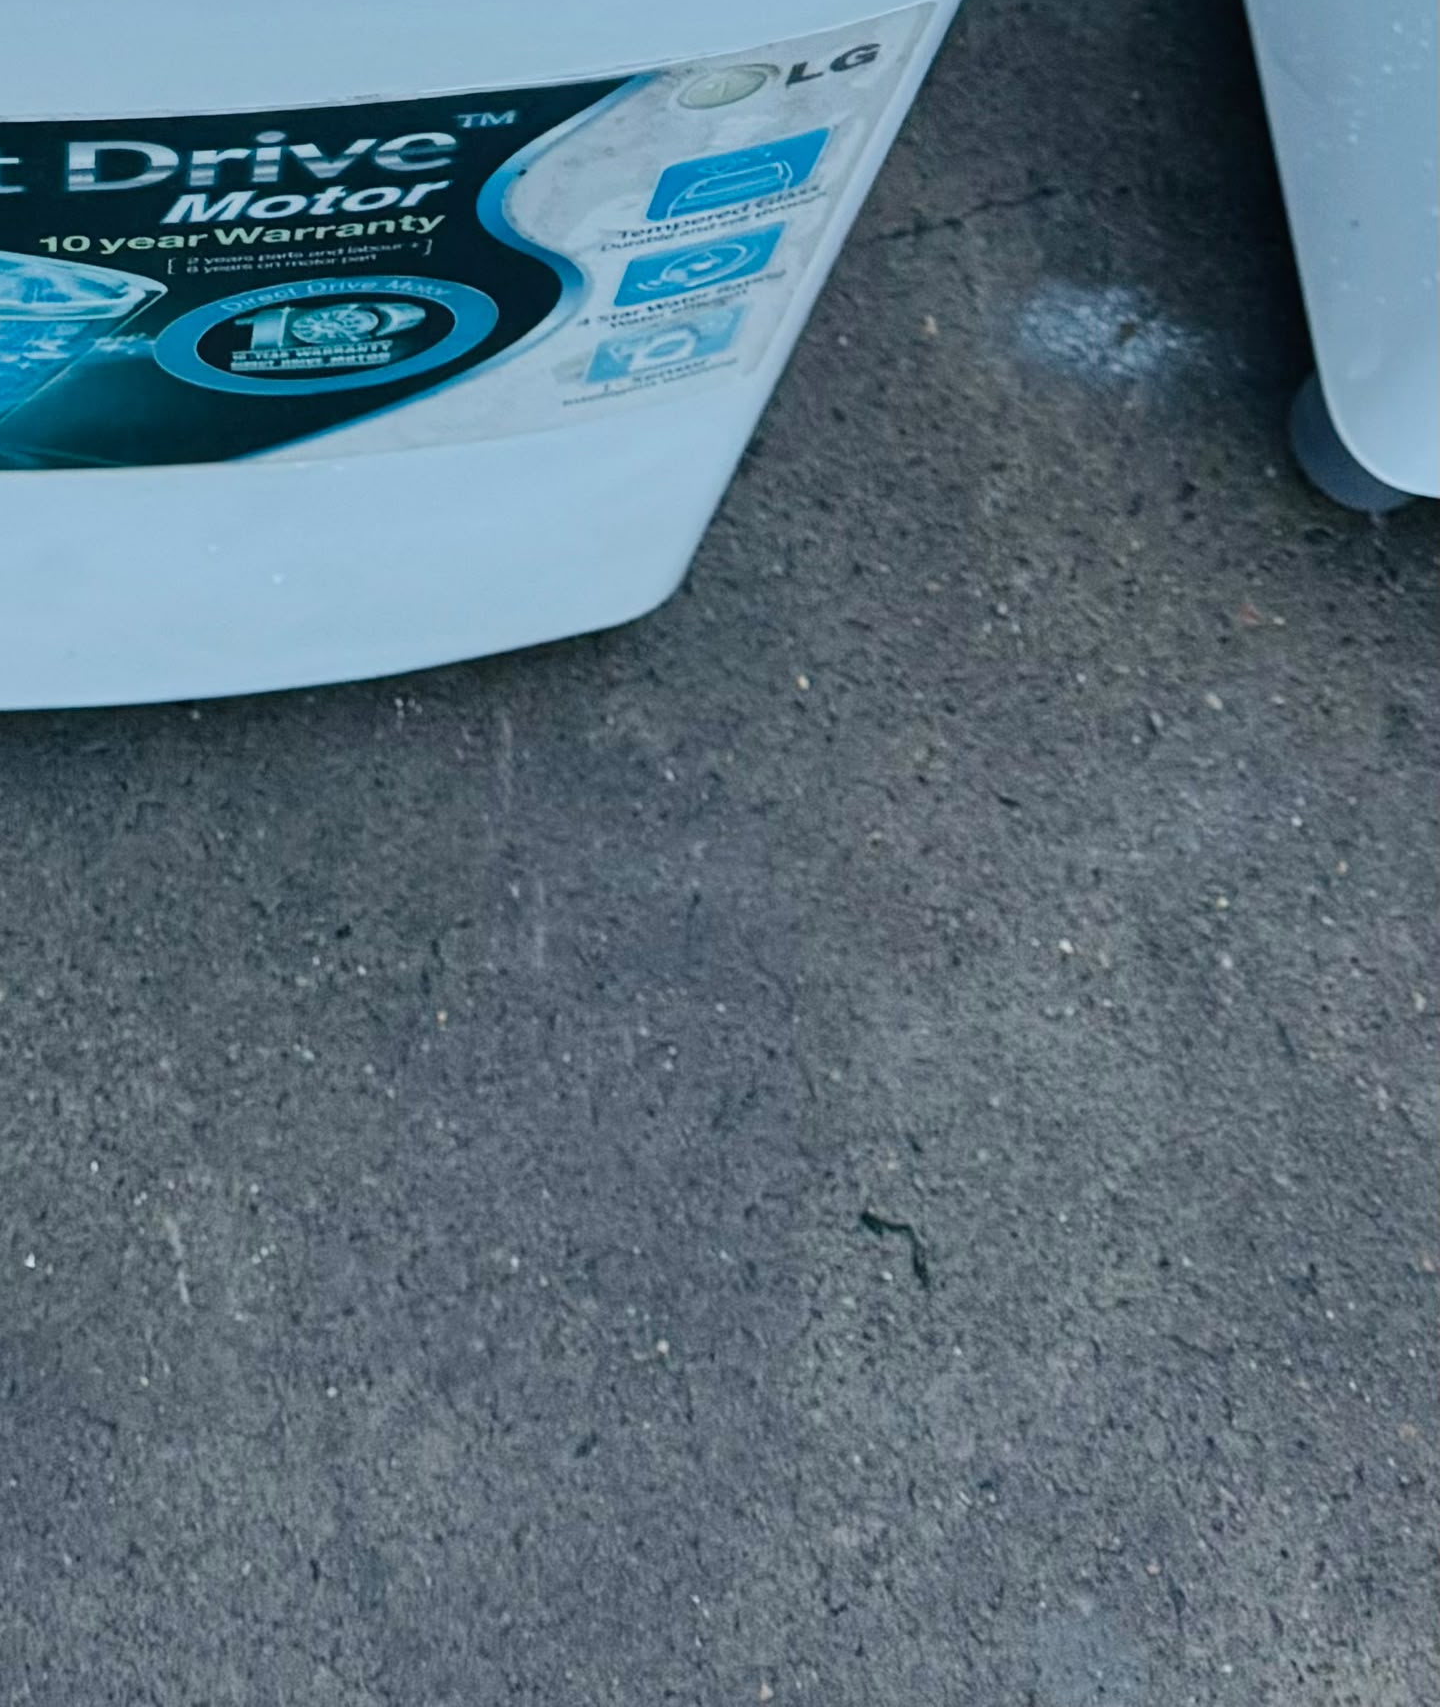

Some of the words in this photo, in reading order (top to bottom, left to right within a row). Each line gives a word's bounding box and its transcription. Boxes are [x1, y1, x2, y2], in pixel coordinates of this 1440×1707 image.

[785, 43, 881, 88] LG
[67, 131, 458, 192] Drive
[160, 180, 453, 224] Motor
[39, 235, 92, 253] 10
[100, 234, 208, 255] year
[213, 214, 446, 246] Warranty
[204, 255, 254, 265] years
[220, 288, 296, 313] Direct
[302, 280, 379, 295] Drive
